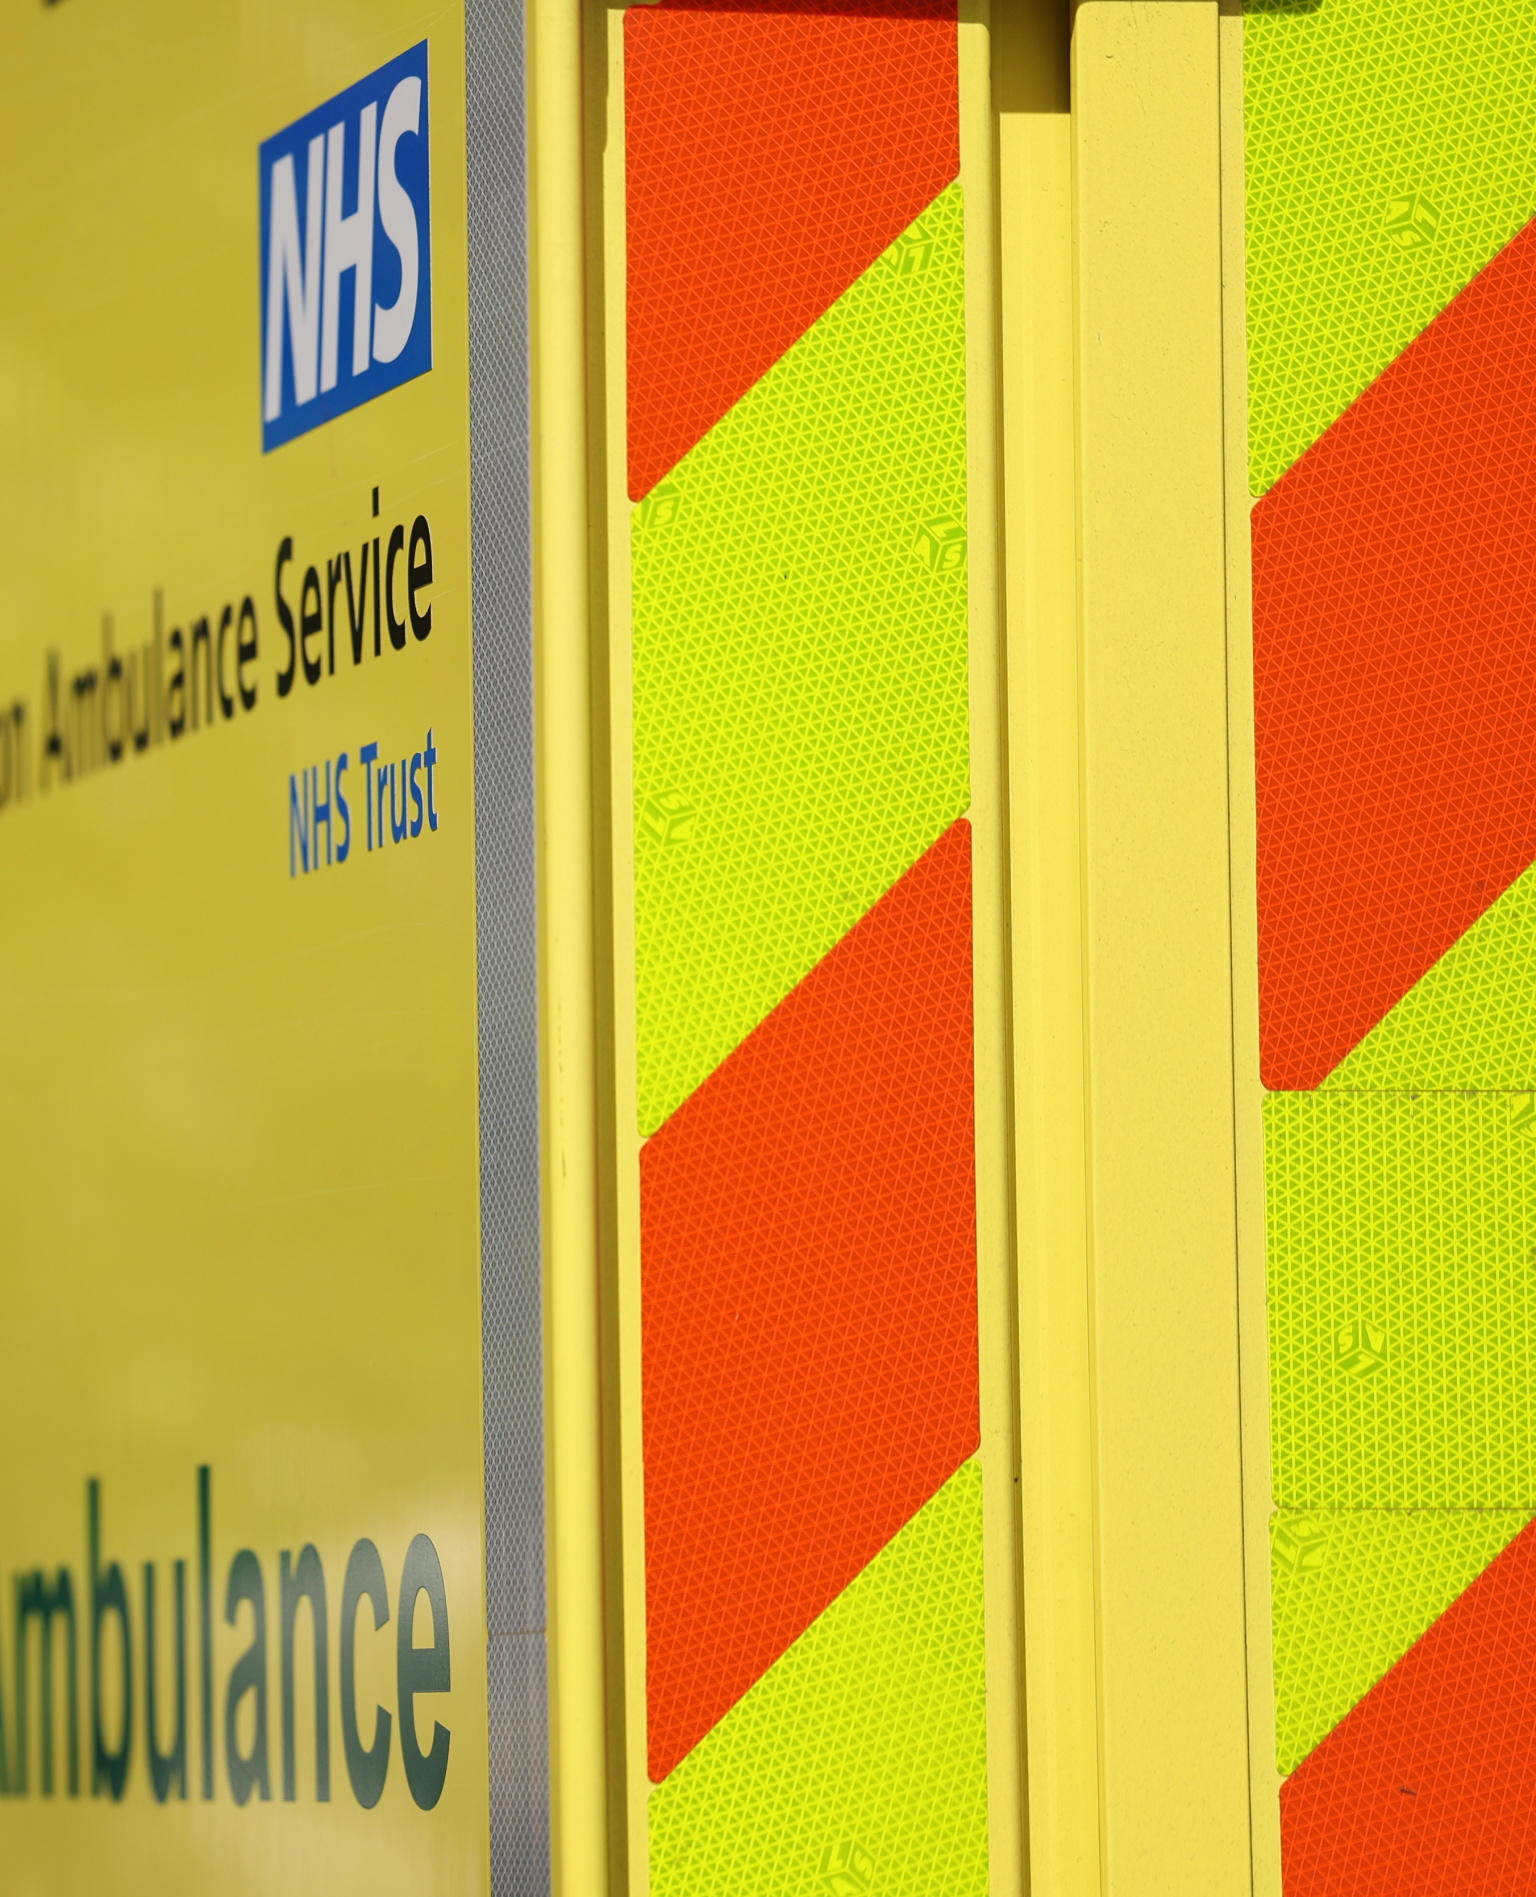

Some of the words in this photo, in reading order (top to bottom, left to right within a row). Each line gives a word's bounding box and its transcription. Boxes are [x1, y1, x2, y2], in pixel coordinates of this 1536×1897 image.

[264, 76, 422, 424] NHS
[40, 587, 260, 791] Ambulance
[274, 485, 433, 698] Service
[289, 752, 351, 879] NHS
[360, 727, 438, 852] Trust
